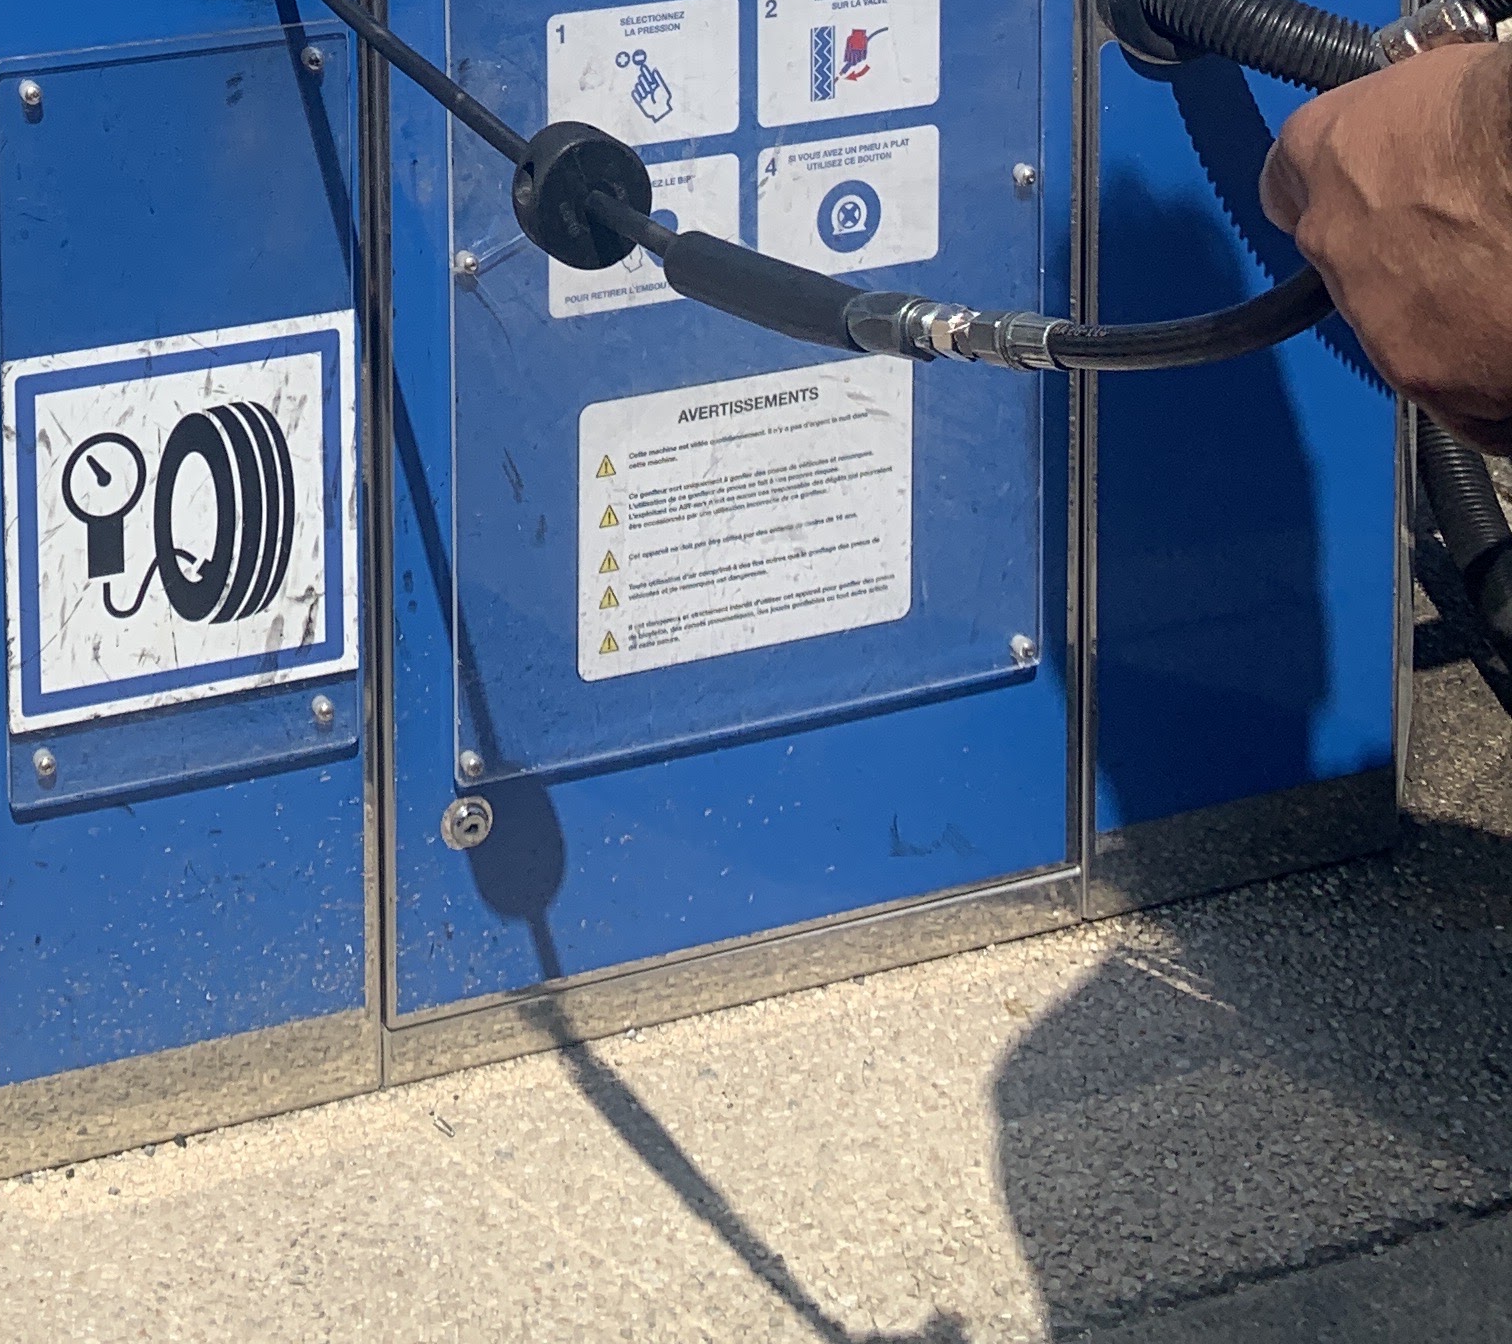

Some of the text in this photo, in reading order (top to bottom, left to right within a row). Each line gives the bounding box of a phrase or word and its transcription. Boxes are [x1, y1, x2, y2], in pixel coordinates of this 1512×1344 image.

[765, 0, 778, 19] 2
[831, 0, 849, 10] SUR
[555, 24, 566, 45] 1
[624, 22, 681, 37] LA PRESSION
[787, 154, 797, 164] SI
[797, 150, 821, 161] VOUS
[822, 147, 843, 158] AVEZ
[844, 145, 857, 155] UN
[858, 142, 881, 152] PNEU
[889, 137, 911, 148] PLAT
[765, 158, 778, 177] 4
[807, 151, 892, 171] UTILISEZ CE BOUTON
[629, 282, 669, 294] L'EMBOU
[678, 387, 819, 423] AVERTISSEMENTS
